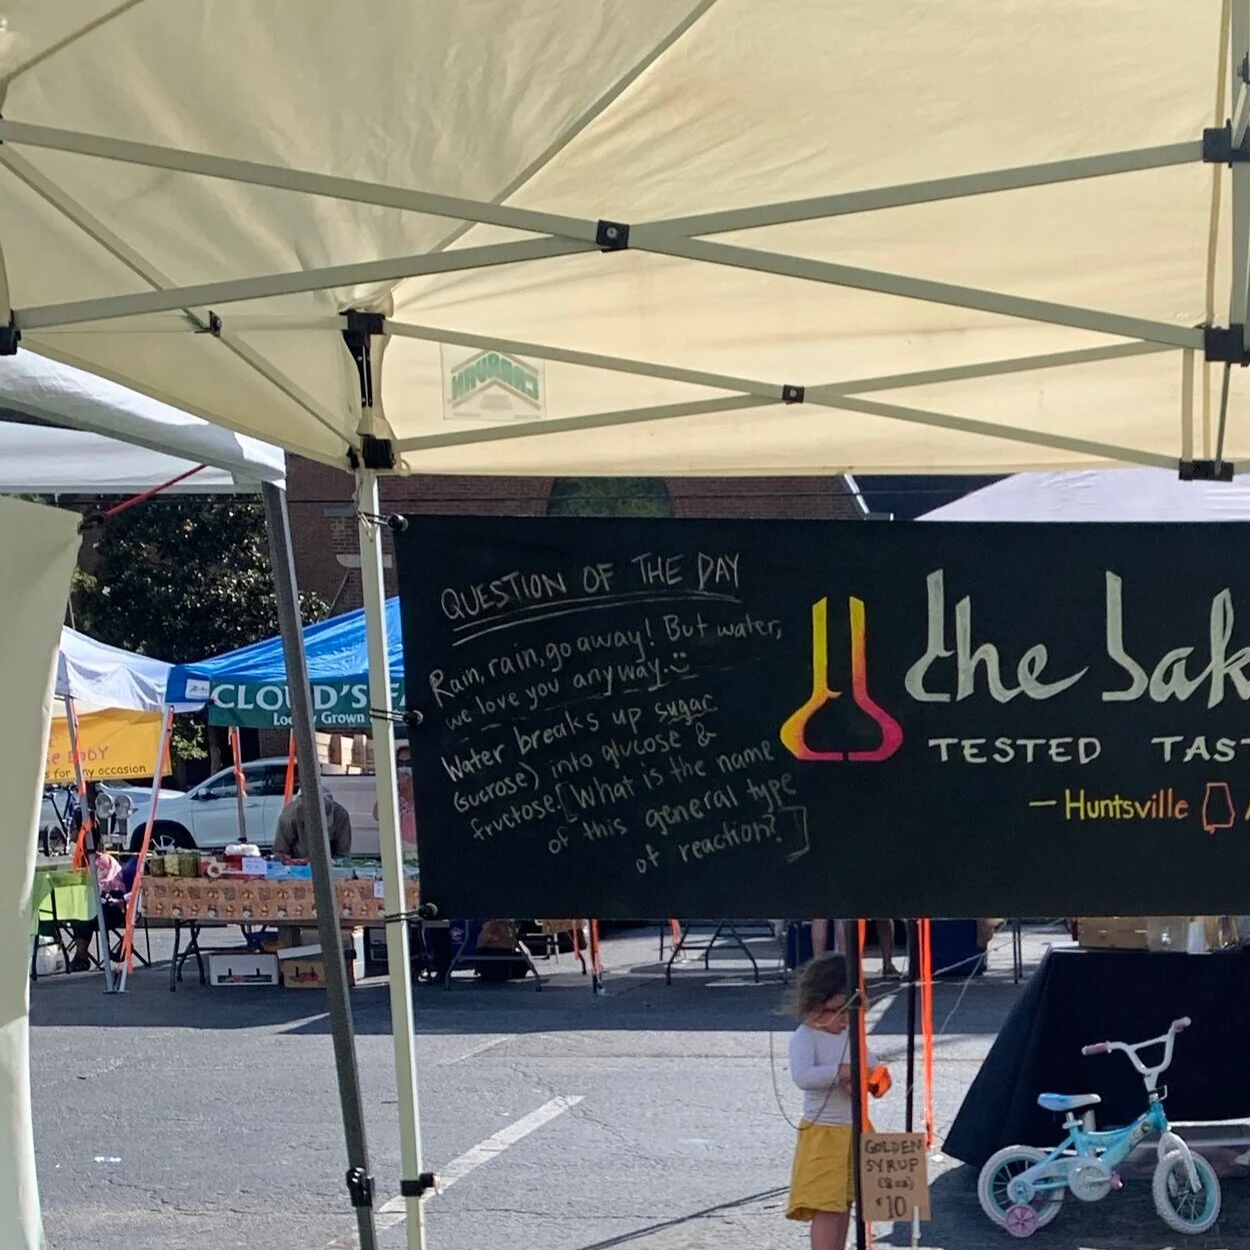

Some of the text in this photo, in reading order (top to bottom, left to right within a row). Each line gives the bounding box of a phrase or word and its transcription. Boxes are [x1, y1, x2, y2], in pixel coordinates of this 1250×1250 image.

[441, 552, 740, 620] QUESTION OF THE DAY
[430, 667, 484, 708] Rain,
[489, 643, 546, 676] rain,
[546, 641, 572, 672] go
[577, 618, 655, 663] away!
[663, 614, 709, 641] But
[718, 613, 782, 640] water,
[211, 684, 367, 710] CLOD'S
[446, 708, 472, 731] we
[476, 692, 519, 715] love
[526, 677, 559, 711] you
[321, 712, 365, 724] Grown
[441, 693, 714, 782] Water breaks up sugar
[929, 737, 1101, 764] TESTED
[54, 768, 71, 778] for
[98, 764, 146, 776] occasion
[454, 724, 716, 813] (sucrose) into glucose &
[641, 762, 664, 790] is
[670, 755, 706, 783] the
[716, 739, 774, 774] name
[549, 771, 797, 854] of this general type
[1064, 787, 1190, 821] Huntsville
[635, 844, 660, 874] of
[864, 1139, 922, 1154] GOLDEN
[866, 1158, 919, 1172] SYRUP
